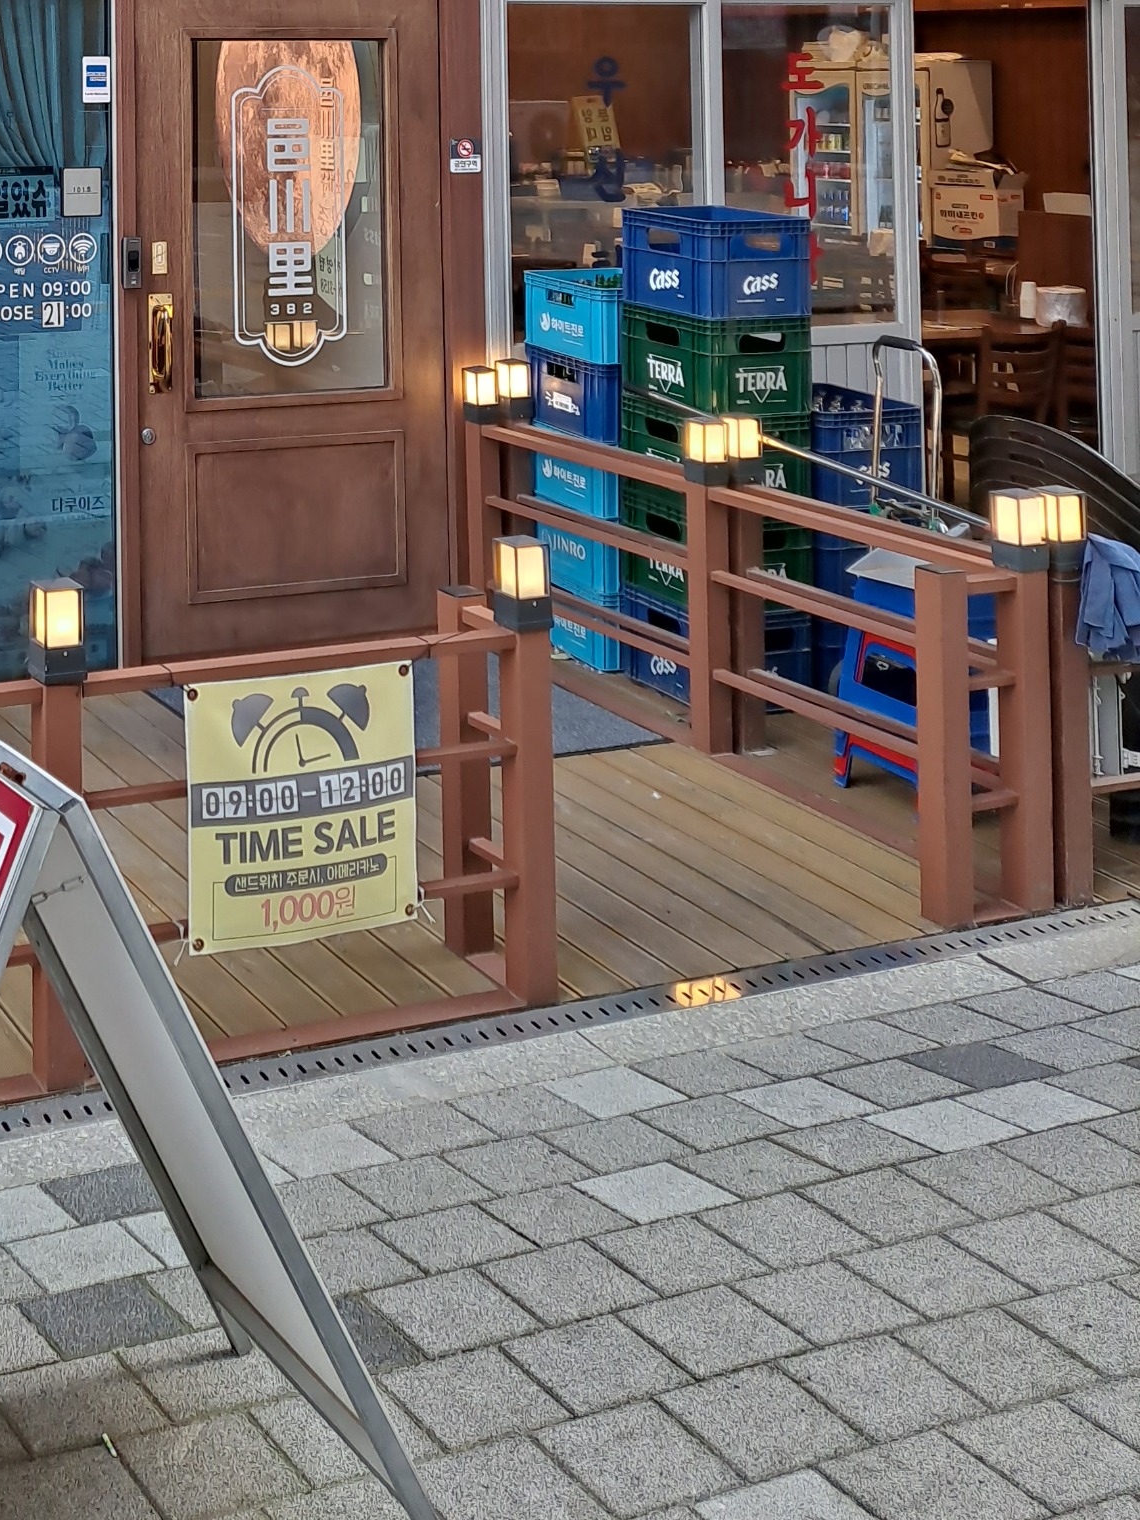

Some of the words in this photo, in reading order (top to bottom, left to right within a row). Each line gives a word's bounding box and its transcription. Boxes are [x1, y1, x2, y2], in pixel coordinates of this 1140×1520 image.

[42, 281, 91, 297] 09:00
[649, 267, 680, 291] Cass
[742, 271, 779, 295] Cass
[270, 303, 313, 316] 382
[551, 317, 584, 337] 하이트진로
[647, 356, 684, 388] TERRA
[736, 367, 788, 393] TERRA
[553, 465, 587, 490] 하이트진로
[552, 533, 586, 561] JINRO
[215, 825, 303, 865] TIME
[314, 808, 396, 855] SALE
[234, 874, 283, 893] 샌드위치
[286, 868, 324, 887] 주문시,
[327, 857, 380, 881] 아메리카노
[261, 884, 356, 932] 1,000원
